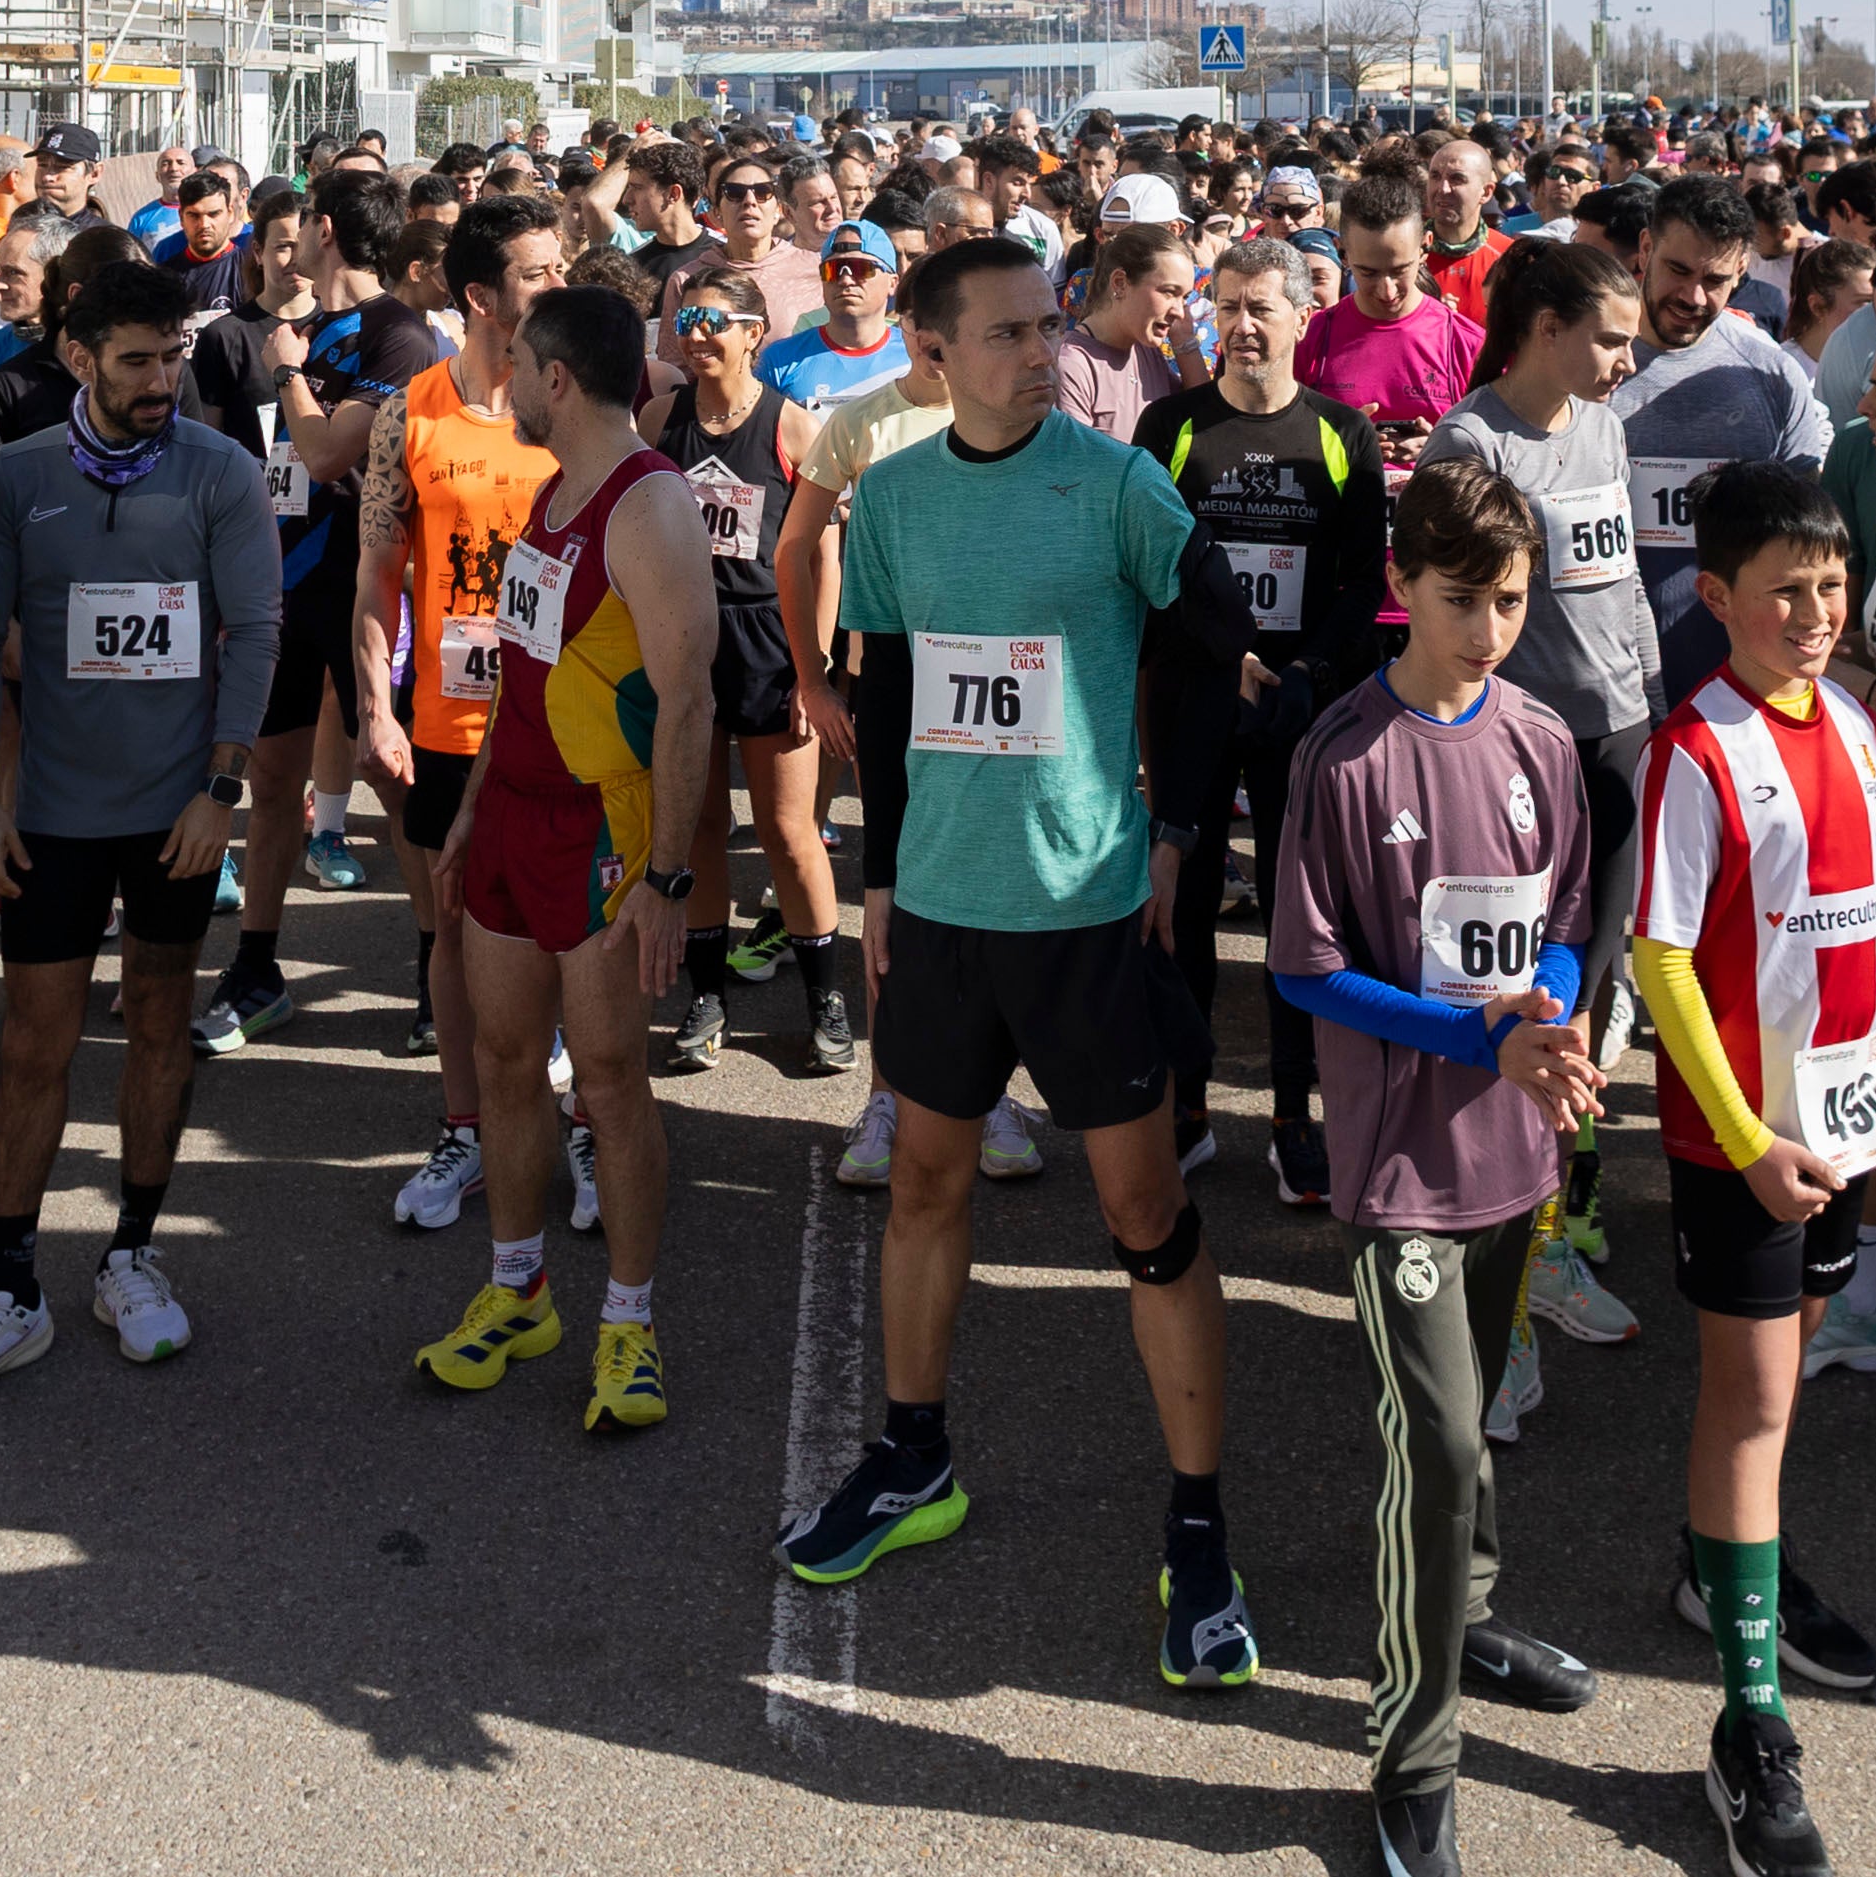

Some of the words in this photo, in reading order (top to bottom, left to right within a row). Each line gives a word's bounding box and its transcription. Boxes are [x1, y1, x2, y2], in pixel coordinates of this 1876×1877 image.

[979, 90, 987, 101] P
[1244, 452, 1275, 464] XXIX
[267, 465, 293, 499] 64
[1197, 500, 1244, 514] MEDIA
[1247, 501, 1319, 520] MARATÓN
[1571, 514, 1628, 563] 568
[1269, 548, 1295, 559] CORRE
[1269, 559, 1294, 571] CAUSA
[85, 587, 136, 596] entreculturas
[158, 599, 186, 610] CAUSA
[507, 575, 540, 631] 148
[95, 614, 172, 657] 524
[932, 639, 983, 652] entreculturas
[1009, 641, 1046, 655] CORRE
[1011, 657, 1045, 671] CAUSA
[948, 673, 1022, 728] 776
[927, 727, 949, 736] CORRE
[950, 729, 963, 737] POR
[963, 730, 973, 738] LA
[1445, 882, 1515, 894] entreculturas
[791, 935, 833, 947] cep
[1440, 981, 1469, 991] CORRE
[1469, 982, 1487, 992] POR
[1488, 983, 1499, 992] LA
[1425, 987, 1466, 999] INFANCIA
